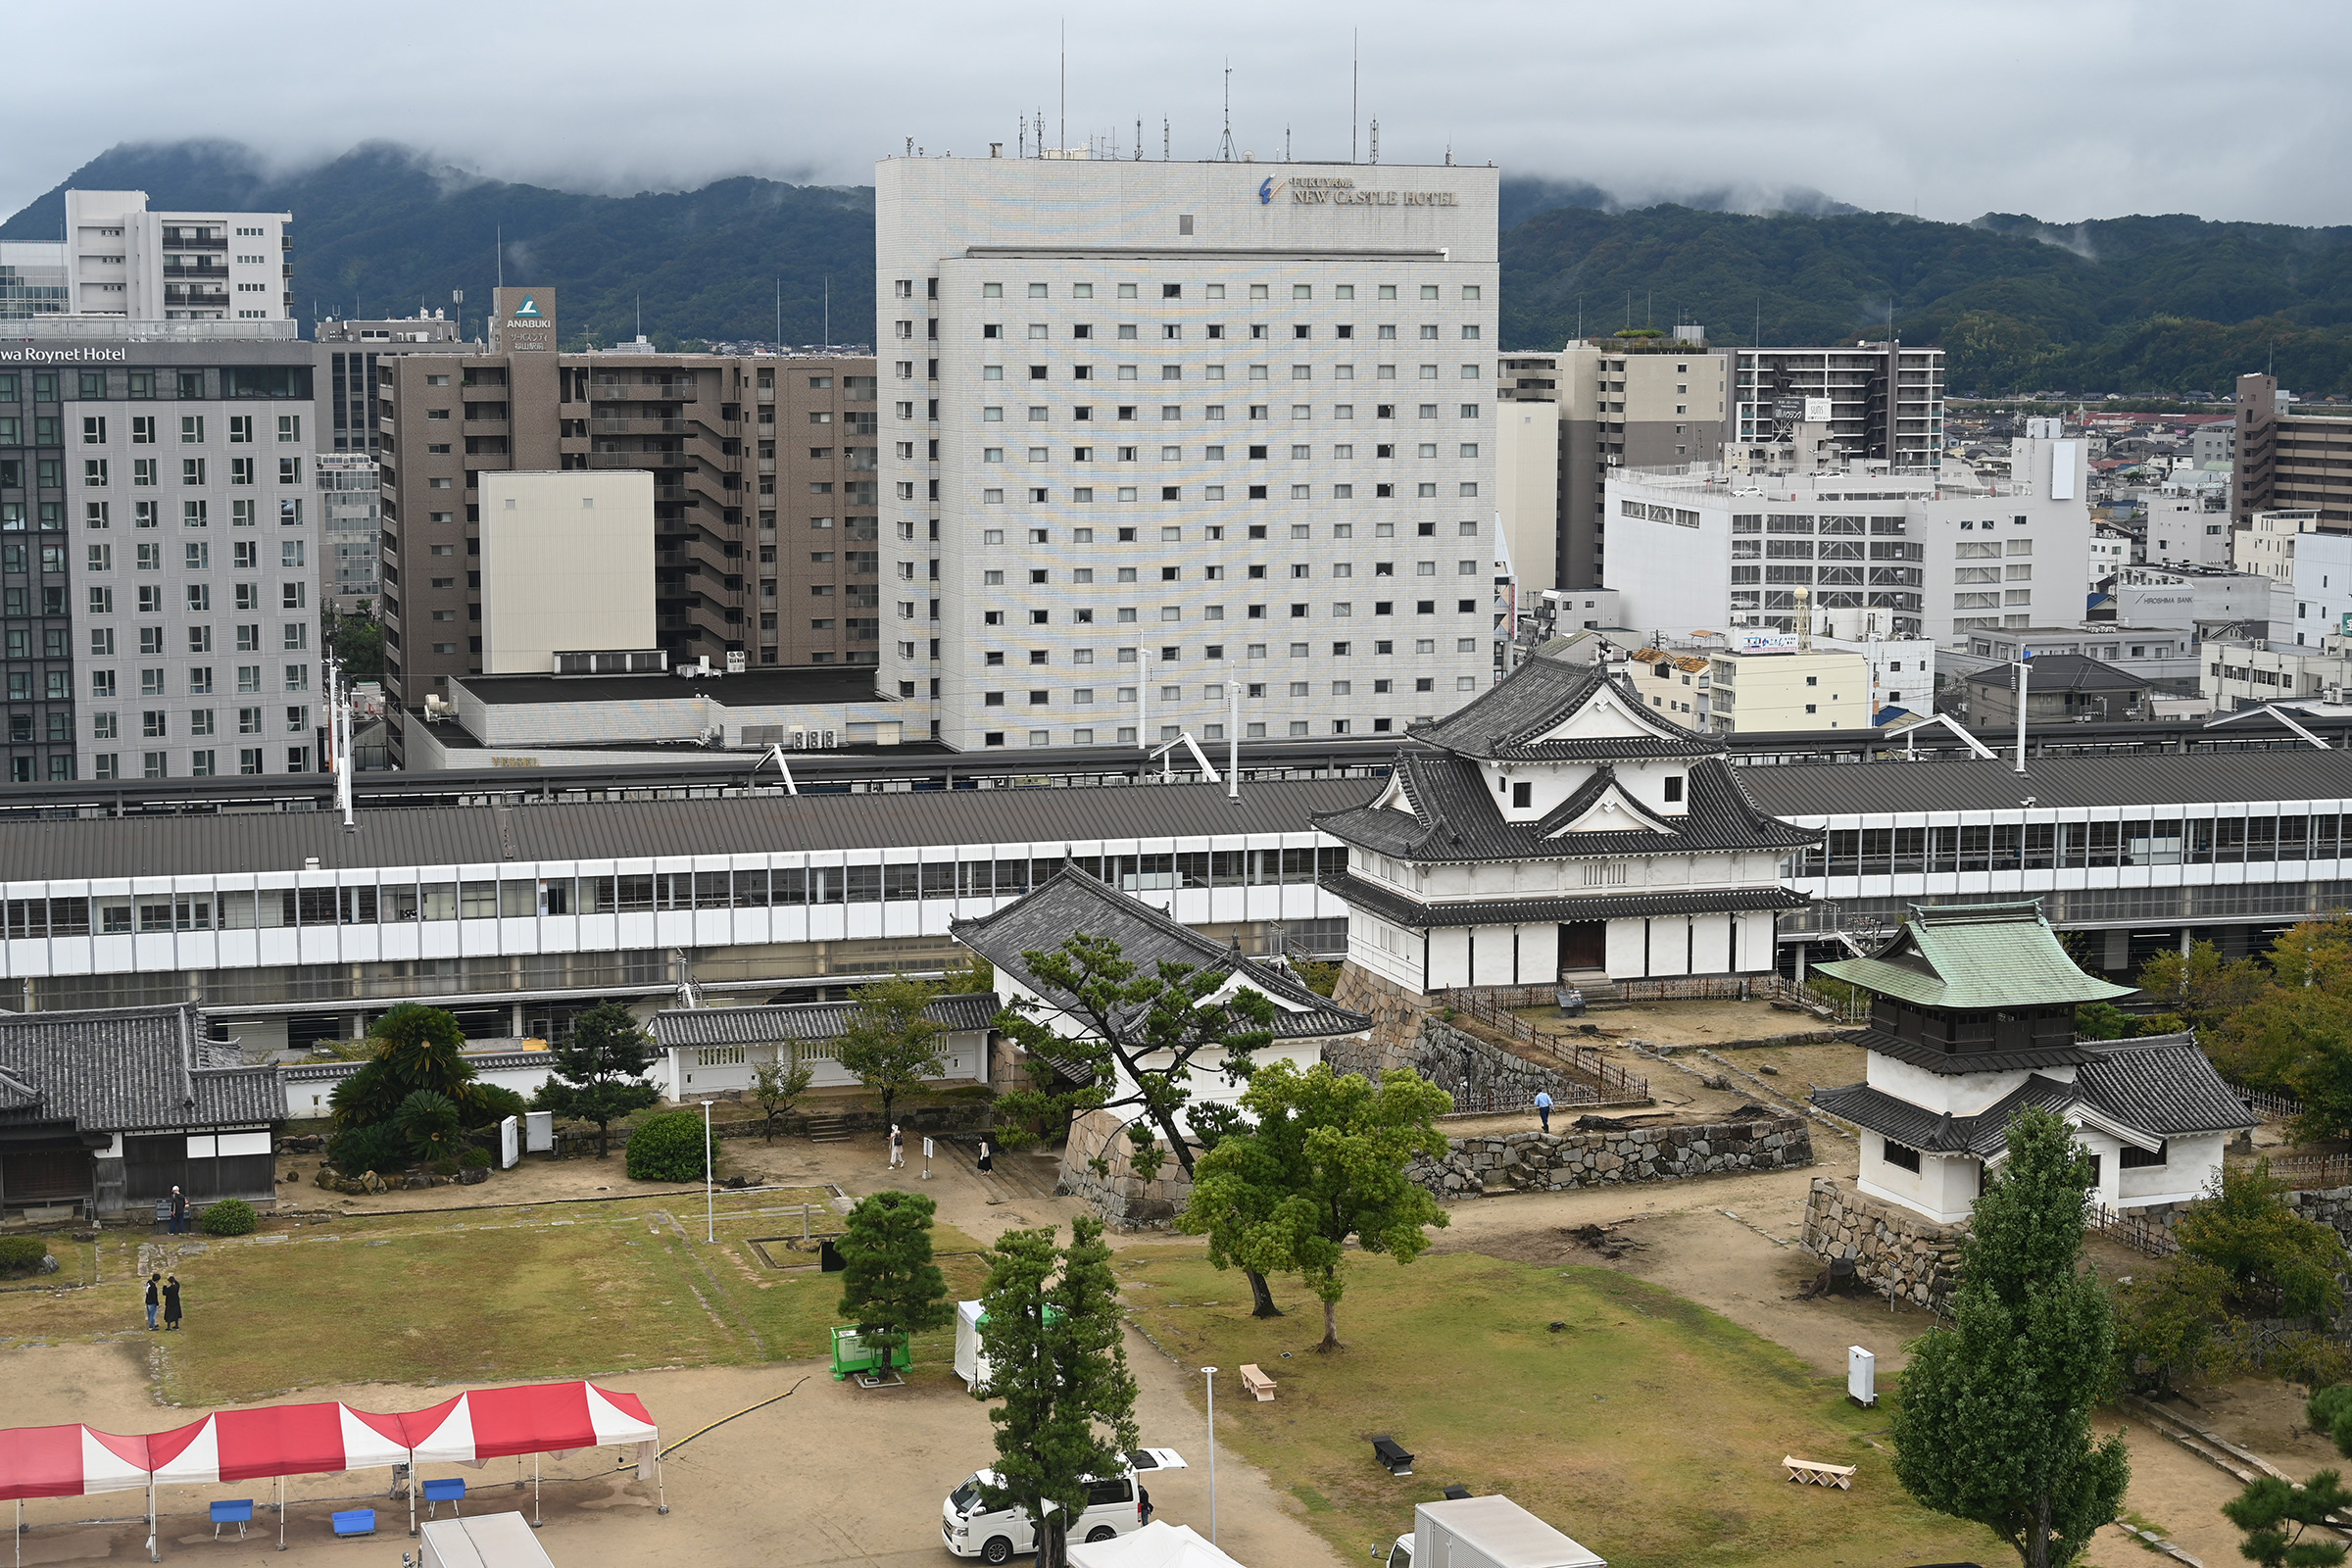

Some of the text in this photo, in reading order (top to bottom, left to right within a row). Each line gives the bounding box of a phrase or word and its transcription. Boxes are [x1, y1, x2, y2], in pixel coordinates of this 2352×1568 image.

[1292, 177, 1355, 188] FUKUYAMA
[1293, 190, 1459, 206] NEW CASTLE HOTEL
[25, 347, 80, 364] Roynet
[84, 347, 125, 360] Hotel
[491, 757, 539, 767] VESSEL
